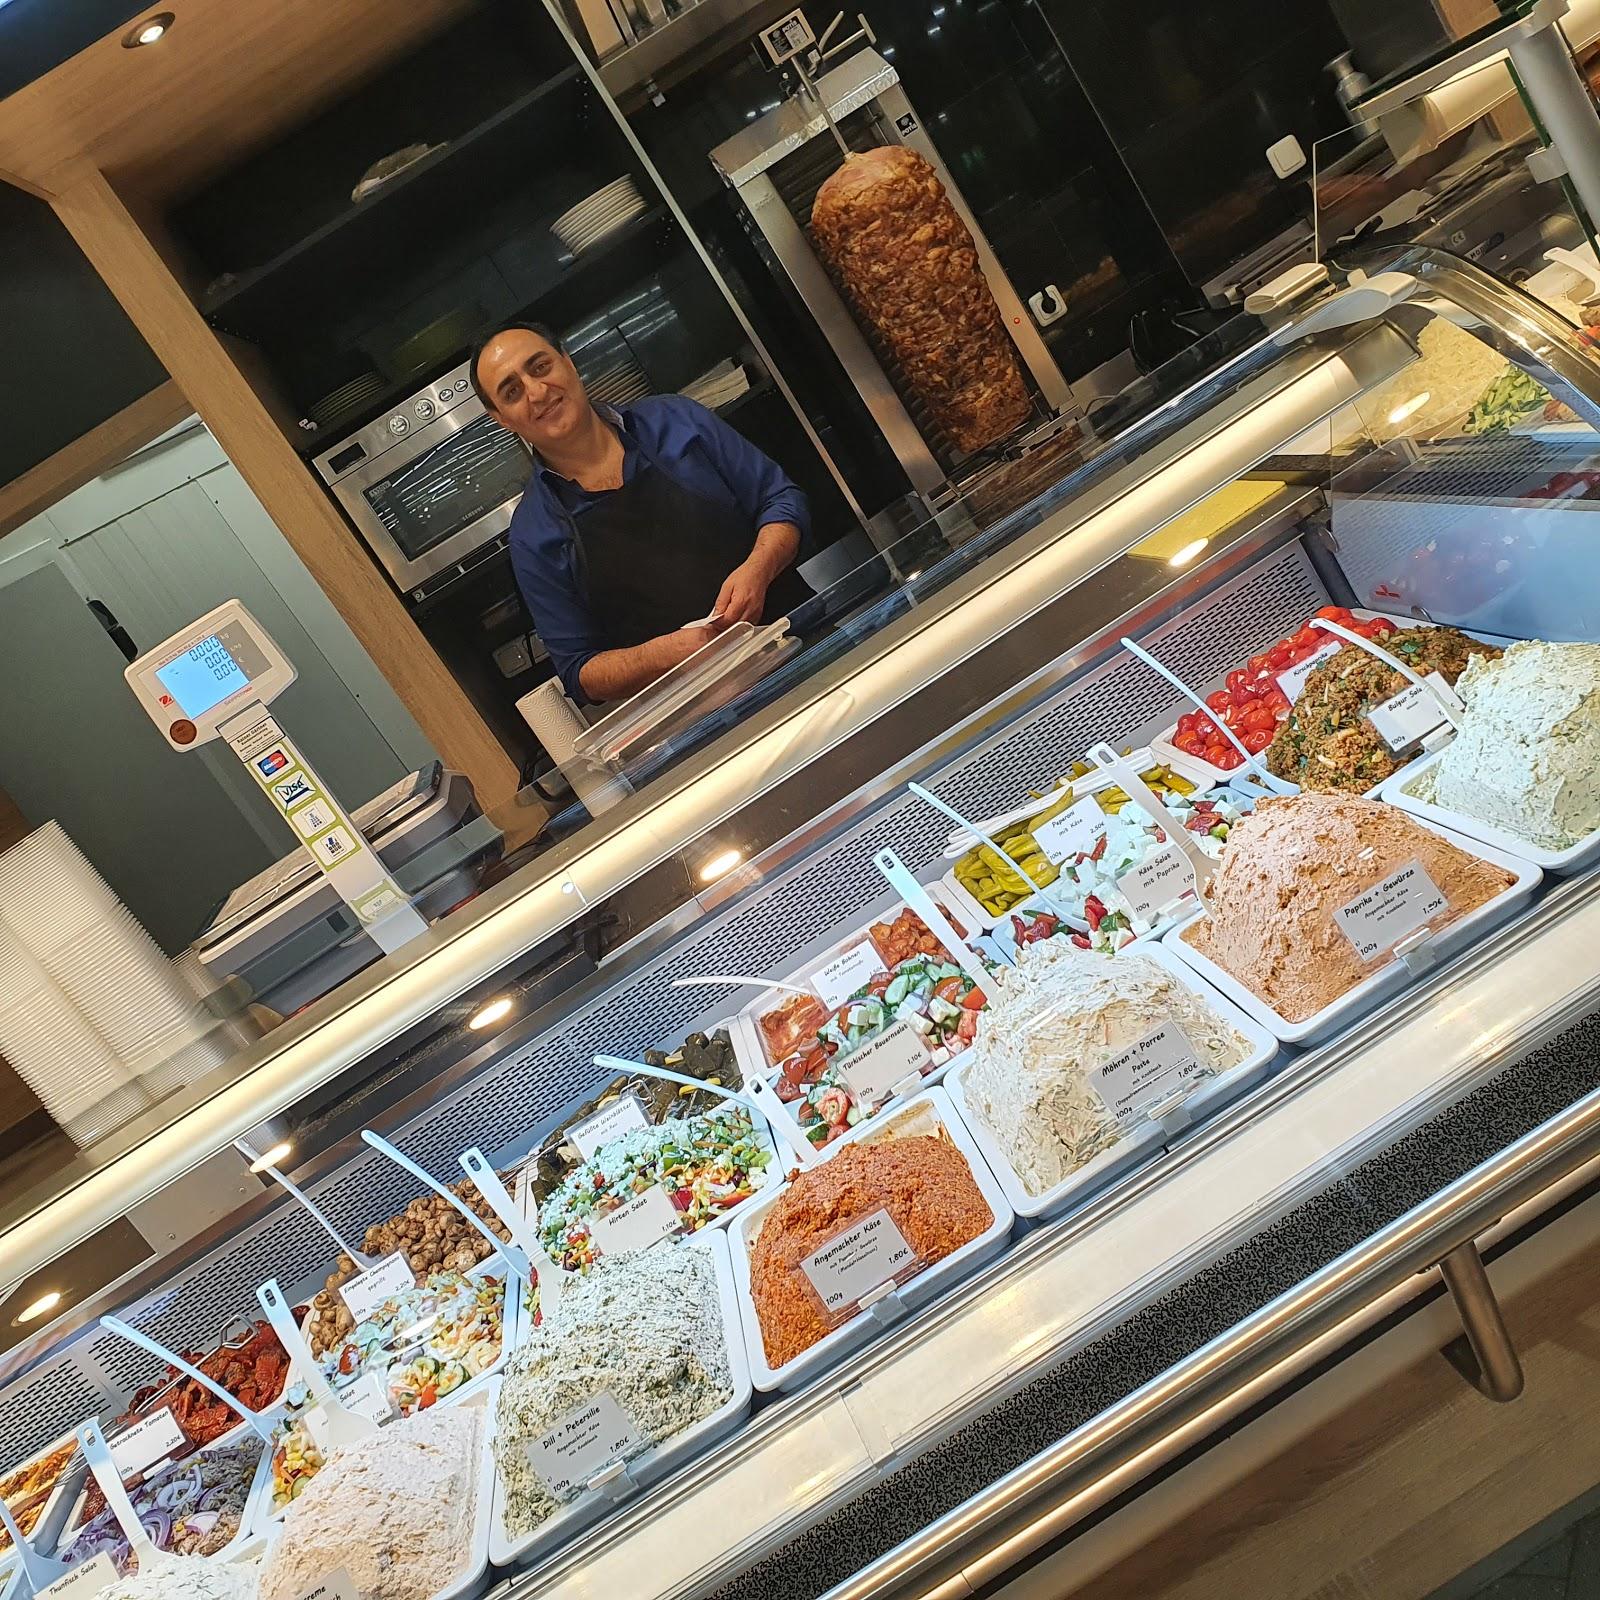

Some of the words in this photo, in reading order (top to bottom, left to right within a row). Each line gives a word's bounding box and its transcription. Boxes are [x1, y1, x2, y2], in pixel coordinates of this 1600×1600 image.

[1388, 695, 1409, 712] Bulgur
[1409, 686, 1423, 698] Sala
[1391, 734, 1406, 746] 100g
[282, 779, 304, 797] VISA
[1049, 850, 1062, 860] 100g
[1138, 863, 1153, 876] Käse
[1154, 852, 1171, 866] Salat
[1143, 877, 1155, 888] mit
[1156, 862, 1180, 880] Paprika
[1344, 895, 1373, 917] Paprika
[1382, 868, 1415, 892] Gewürze
[1135, 902, 1150, 913] 100g
[1360, 942, 1378, 956] 100g
[842, 1048, 873, 1071] Türkischer
[874, 1023, 908, 1050] Bauernsalat
[1101, 1054, 1130, 1077] Möhren
[1139, 1031, 1166, 1051] Porree
[907, 1051, 922, 1065] 1,10€
[1131, 1058, 1150, 1074] Paste
[1178, 1061, 1199, 1079] 1,80€
[859, 1086, 874, 1098] 100g
[1116, 1106, 1134, 1119] 100g
[608, 1208, 630, 1226] Hirten
[630, 1197, 648, 1212] Salat
[661, 1219, 677, 1232] 1,10€
[812, 1230, 862, 1268] Angemachter
[862, 1217, 882, 1233] Käse
[888, 1247, 909, 1265] 1,80€
[825, 1291, 844, 1306] 100g
[338, 1388, 356, 1403] Salat
[371, 1408, 387, 1421] 1,10€
[109, 1426, 143, 1450] Getrocknete
[144, 1410, 169, 1427] Tomaten
[542, 1435, 557, 1450] Dill
[564, 1405, 601, 1433] Petersilie
[165, 1435, 181, 1448] 2,20€
[609, 1436, 630, 1454] 1,80€
[552, 1478, 571, 1493] 100g
[49, 1573, 79, 1596] Thunfisch
[79, 1561, 98, 1576] Salat
